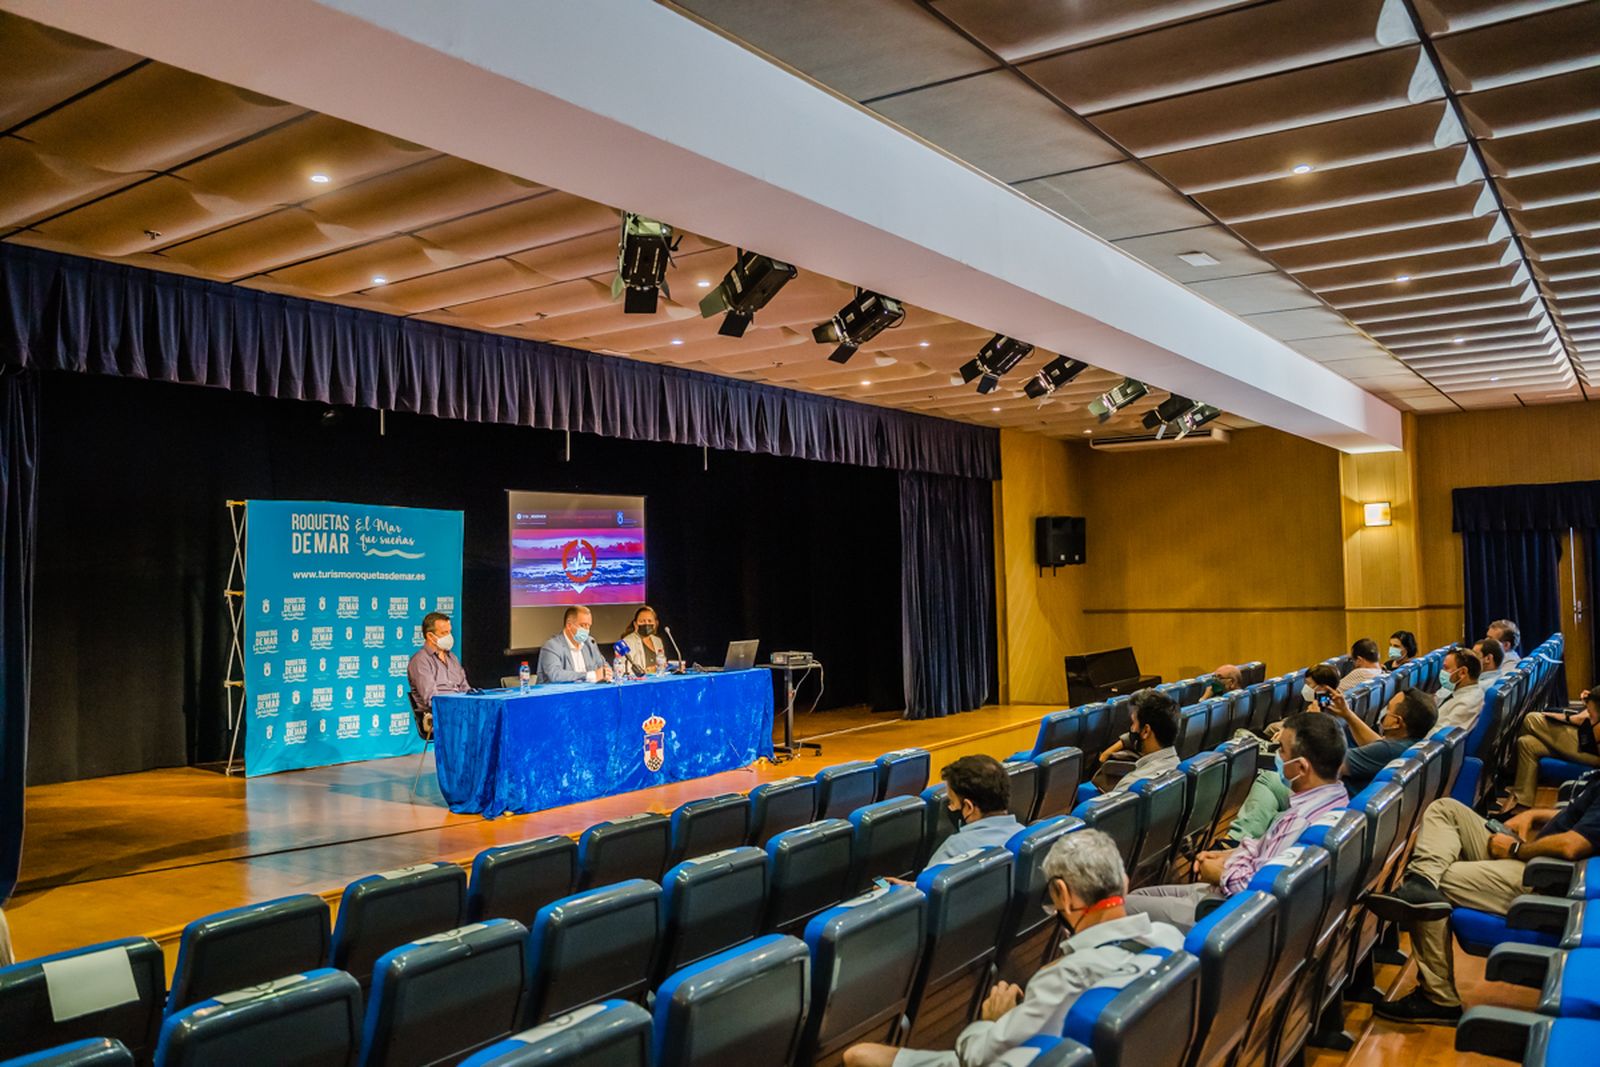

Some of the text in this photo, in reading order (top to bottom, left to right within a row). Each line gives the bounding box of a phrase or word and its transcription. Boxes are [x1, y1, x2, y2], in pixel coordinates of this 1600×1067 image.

[292, 514, 349, 531] ROQUETAS
[355, 516, 402, 534] El Mar
[292, 532, 349, 554] DE MAR
[356, 534, 415, 551] que sueñas
[293, 570, 426, 580] www.turismoroquetasdemar.es
